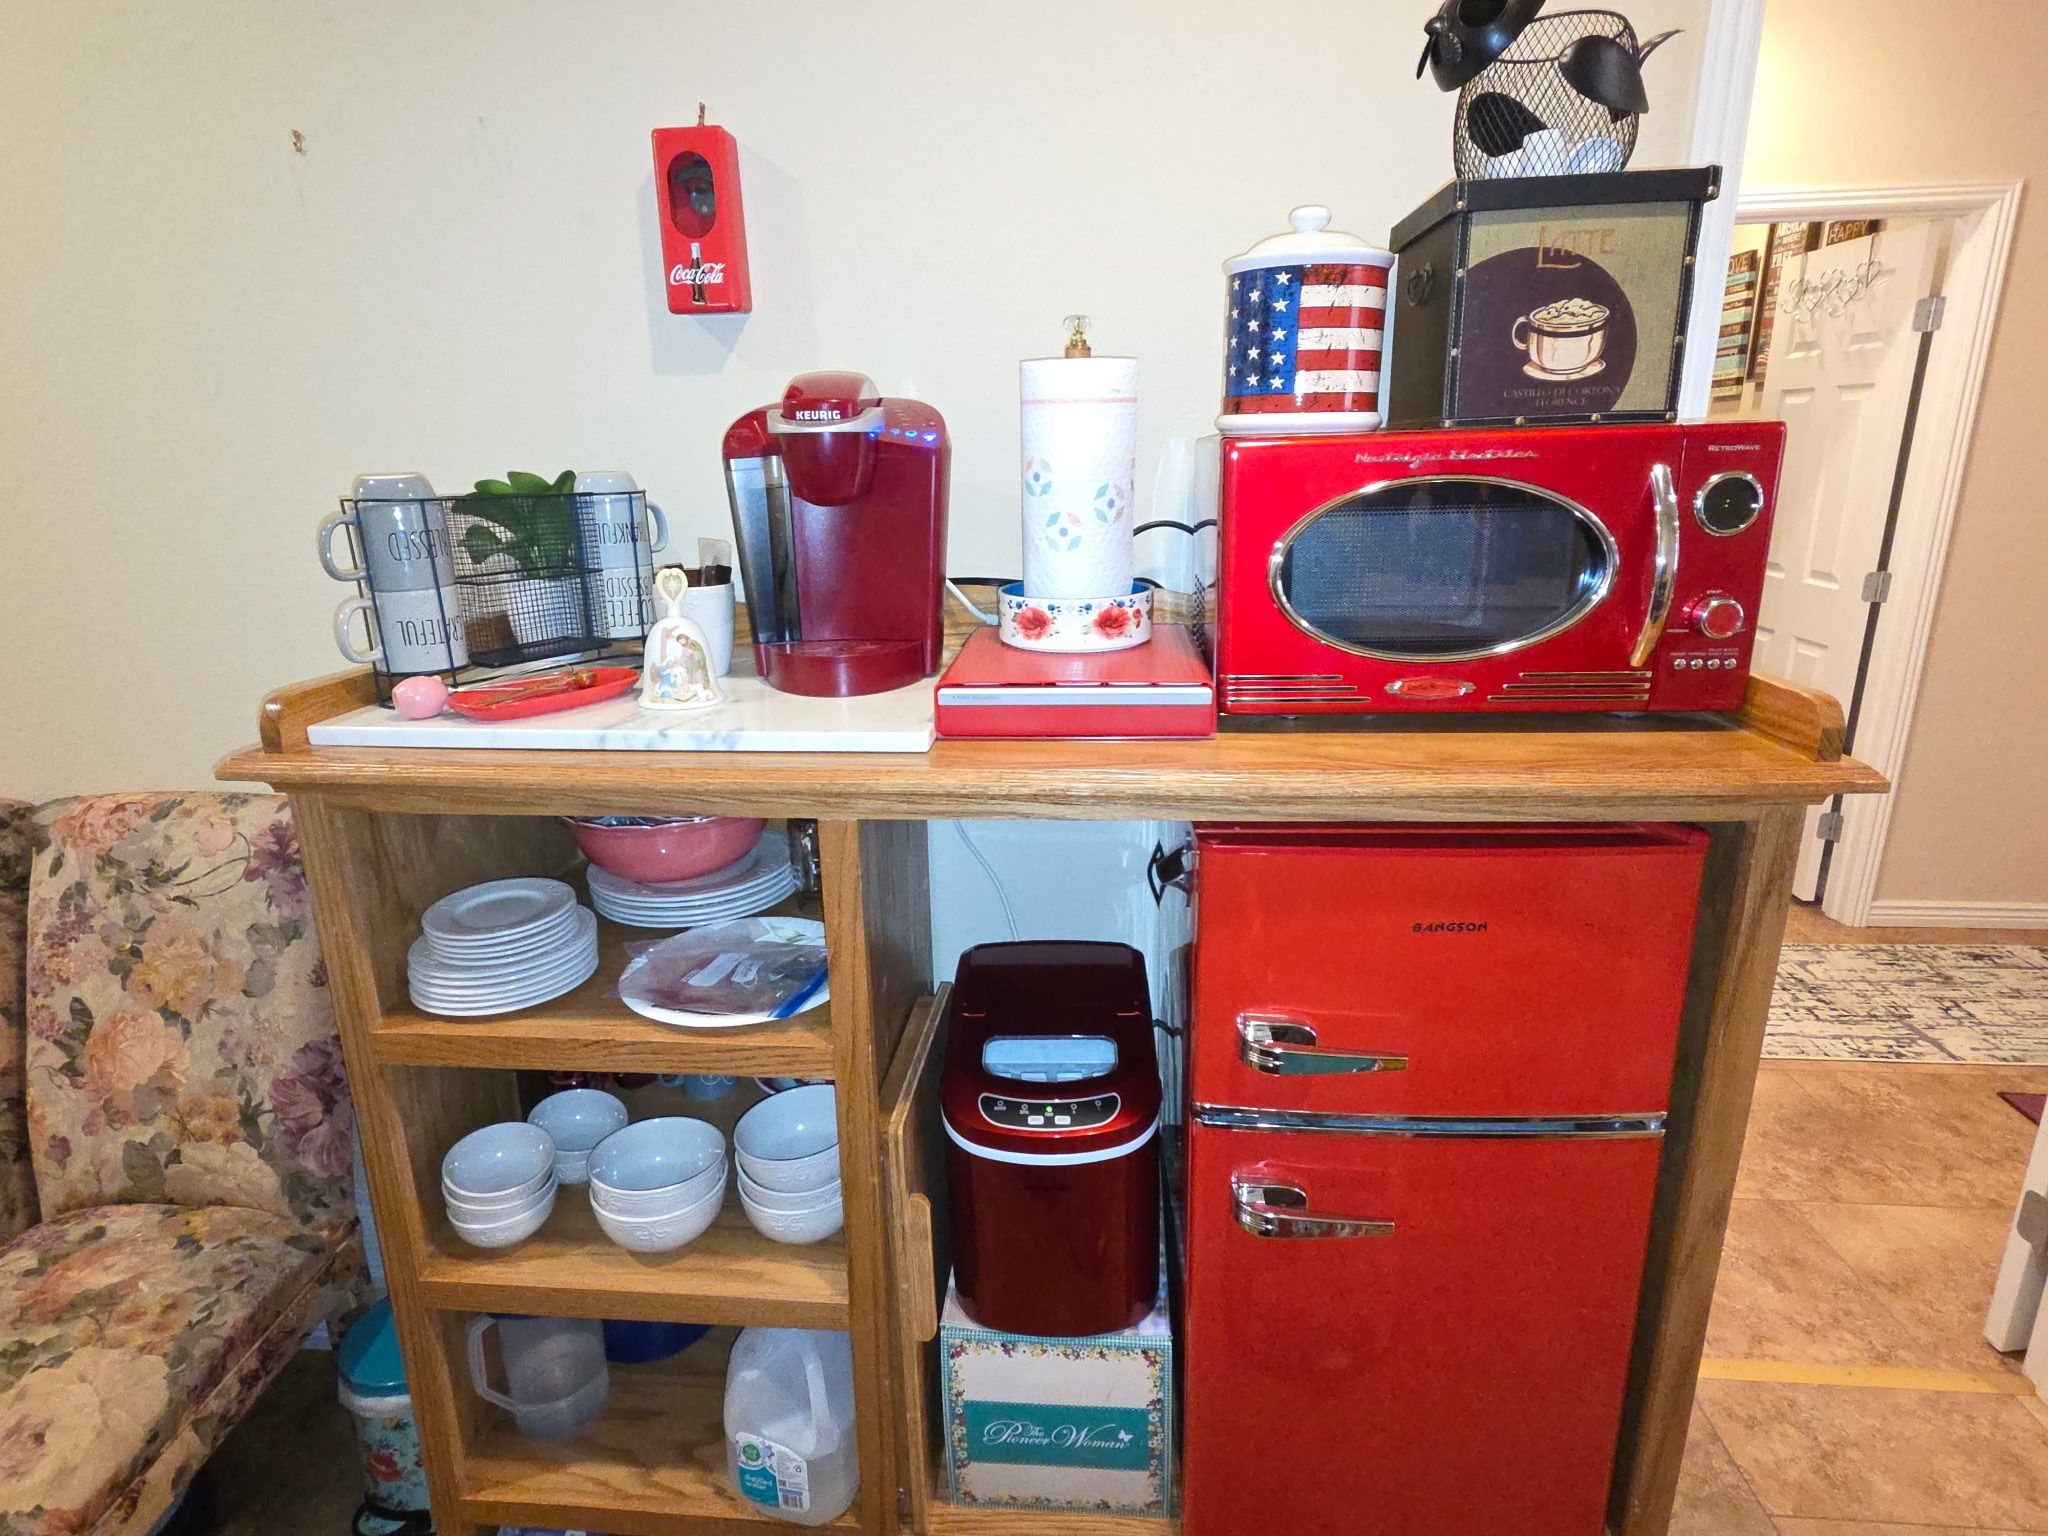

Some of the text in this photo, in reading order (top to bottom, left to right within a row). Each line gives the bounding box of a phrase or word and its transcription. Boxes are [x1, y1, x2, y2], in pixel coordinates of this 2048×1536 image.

[1829, 220, 1869, 241] HAPPY
[1536, 225, 1615, 269] LATTE
[669, 262, 726, 285] Coca-Cola
[1728, 257, 1748, 274] OVE
[795, 410, 841, 420] KEURIG
[1354, 451, 1442, 470] Nostalgia
[594, 521, 647, 545] THANKFUL
[388, 528, 449, 562] BLESSED
[607, 598, 657, 628] COFFEE
[395, 614, 464, 646] GRATEFUL
[1412, 922, 1488, 933] BANGSON
[983, 1420, 1126, 1449] Pioneer Woman
[1022, 1421, 1045, 1437] The
